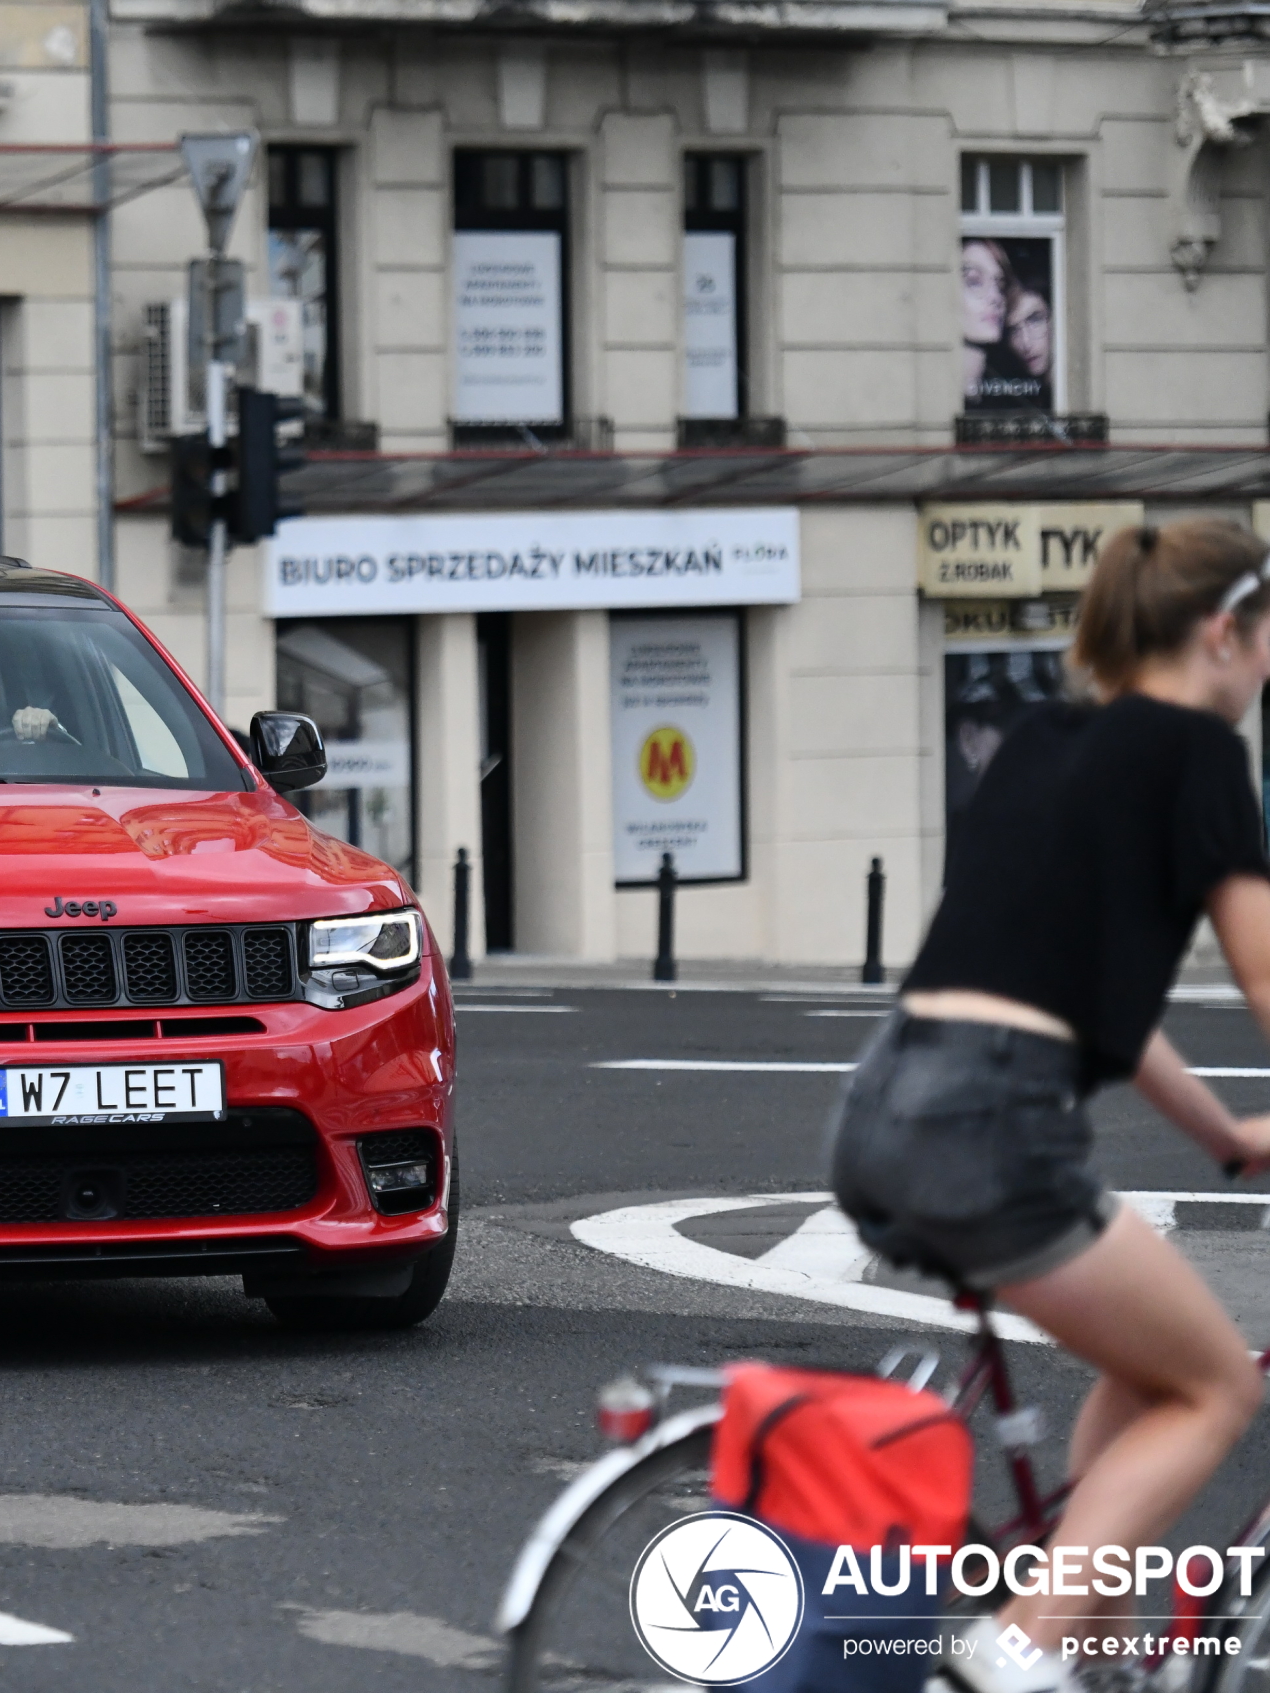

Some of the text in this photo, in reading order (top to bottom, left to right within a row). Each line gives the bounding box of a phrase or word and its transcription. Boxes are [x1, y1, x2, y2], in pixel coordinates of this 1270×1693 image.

[930, 519, 1021, 551] OPTYK
[280, 555, 378, 586] BIURO
[386, 542, 565, 583] SPRZEDAŻY
[573, 538, 723, 578] MIESZKAŃ
[647, 739, 688, 784] M
[44, 896, 117, 921] Jeep
[20, 1068, 204, 1112] W7 LEET
[51, 1113, 166, 1125] RAGECARS
